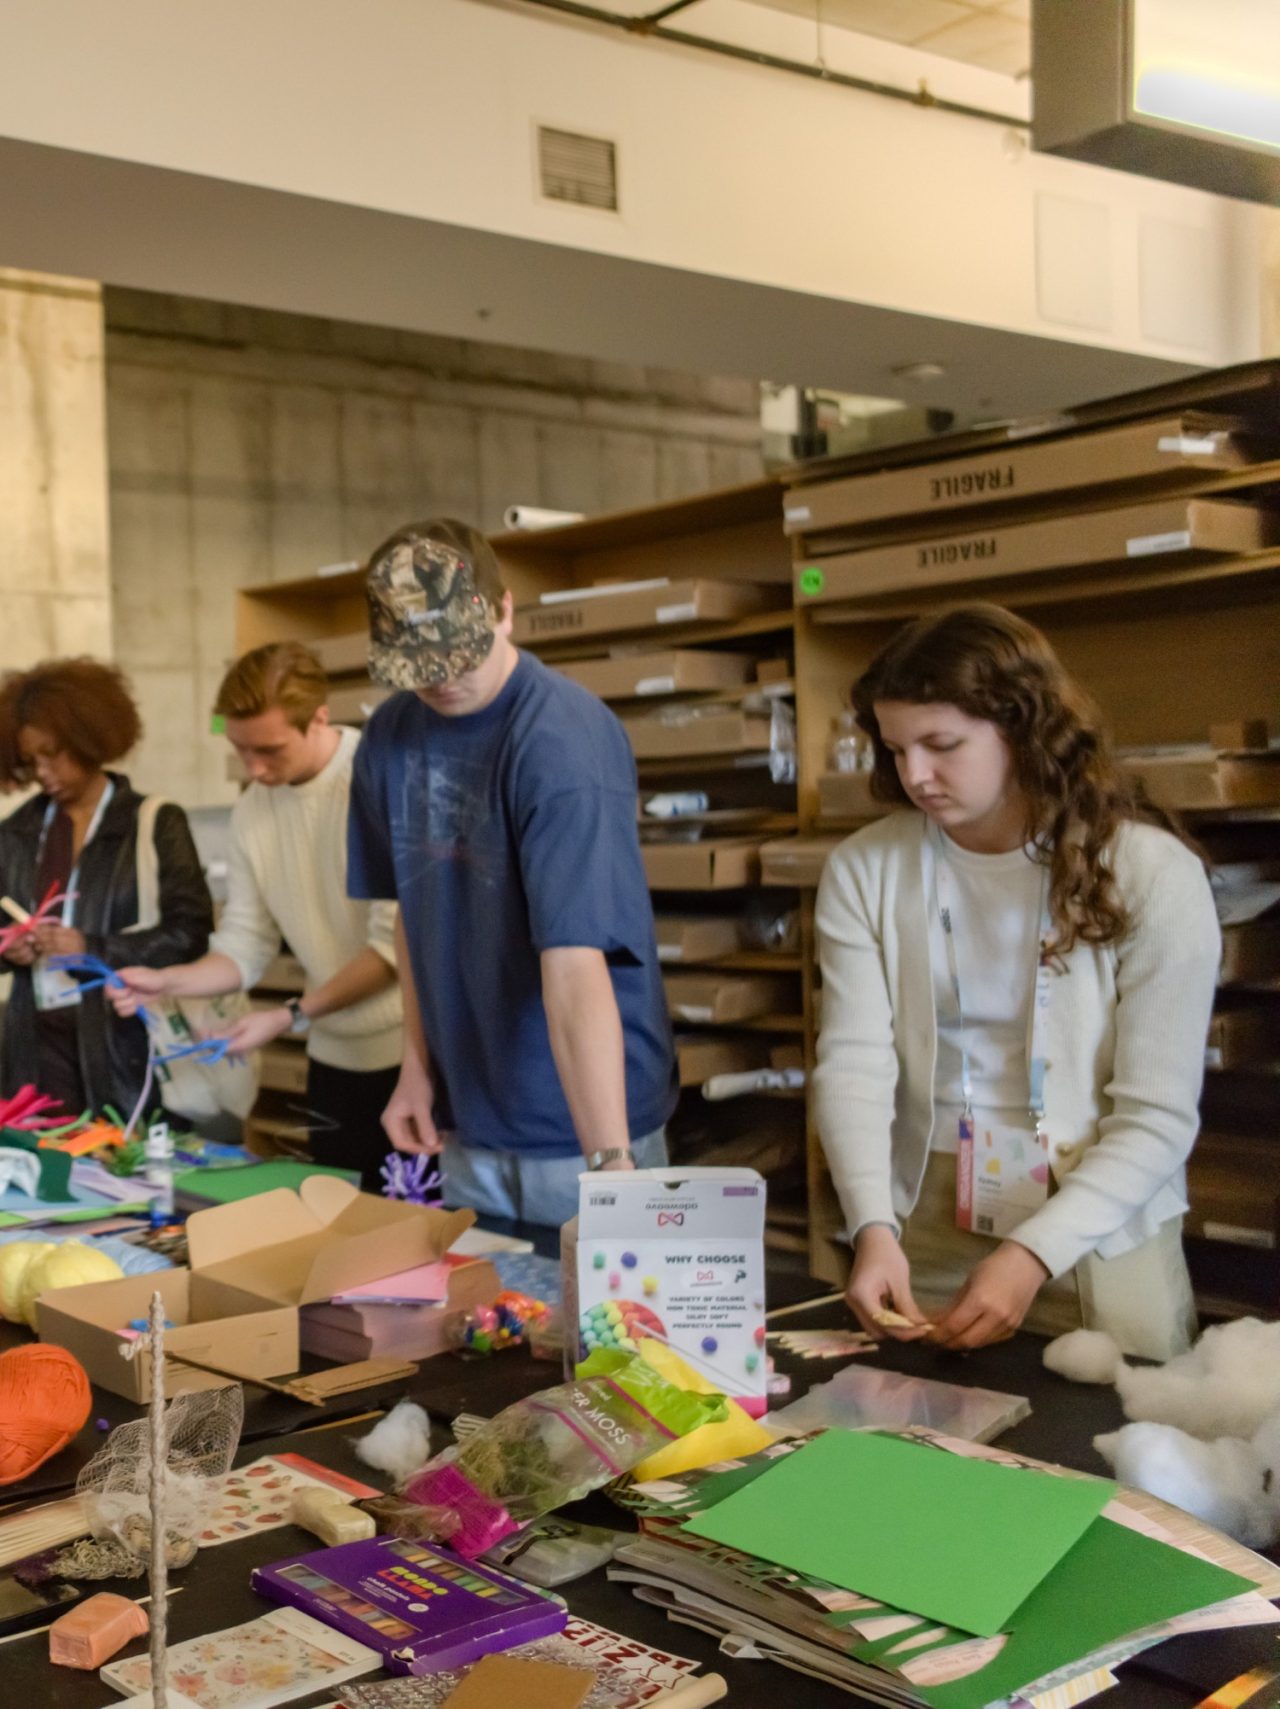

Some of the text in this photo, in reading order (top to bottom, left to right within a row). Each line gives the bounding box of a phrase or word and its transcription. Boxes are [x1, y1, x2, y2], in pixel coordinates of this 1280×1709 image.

[930, 464, 1015, 499] FRAGILE
[917, 537, 997, 568] FRAGILE
[665, 1255, 746, 1264] WHY CHOOSE
[587, 1407, 632, 1446] MOSS
